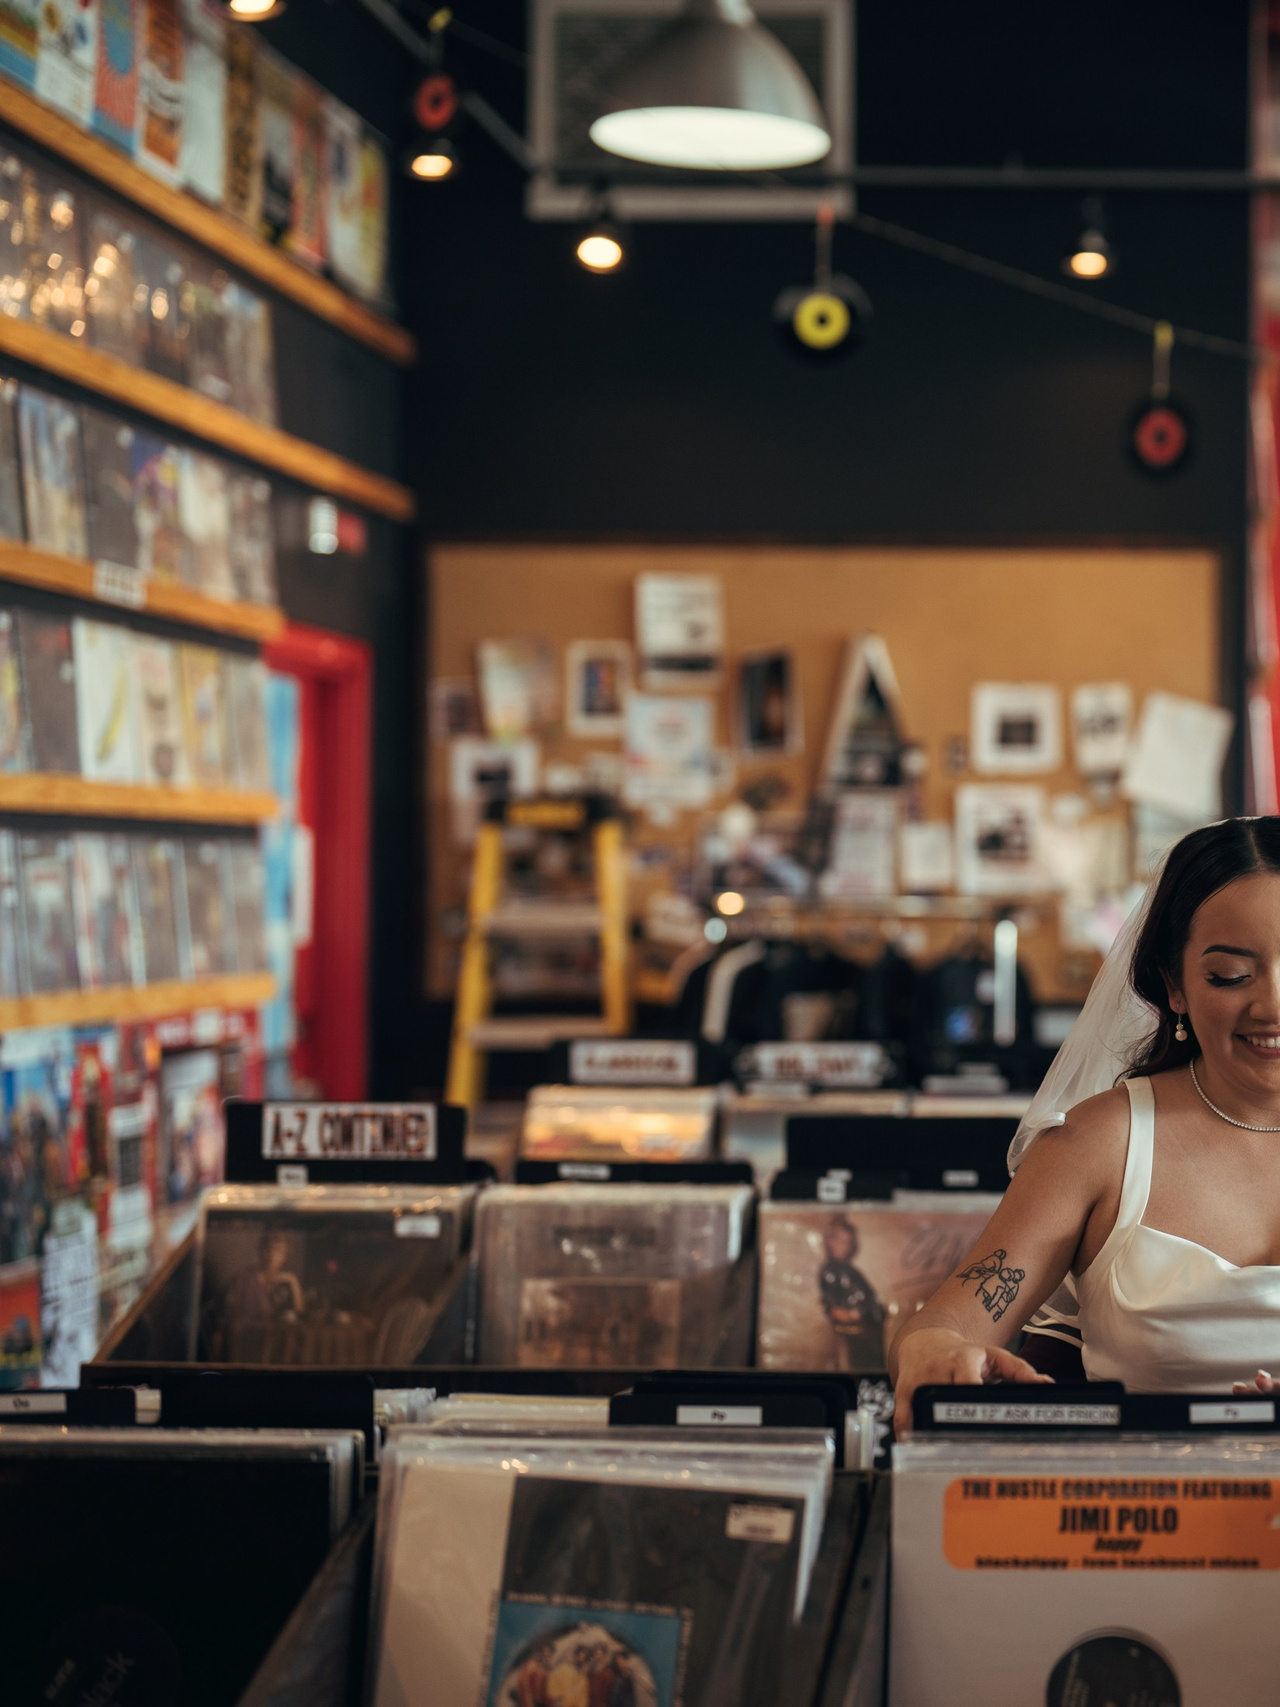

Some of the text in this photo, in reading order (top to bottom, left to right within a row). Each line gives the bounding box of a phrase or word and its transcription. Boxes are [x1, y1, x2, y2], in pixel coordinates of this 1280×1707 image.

[271, 1112, 307, 1154] A-Z
[945, 1406, 977, 1420] EDM
[1004, 1408, 1032, 1420] ASK
[1035, 1408, 1065, 1421] FOR
[961, 1480, 1272, 1499] THE HUSTLE CORPORATION FEATURING
[1059, 1506, 1179, 1533] JIMI POLO
